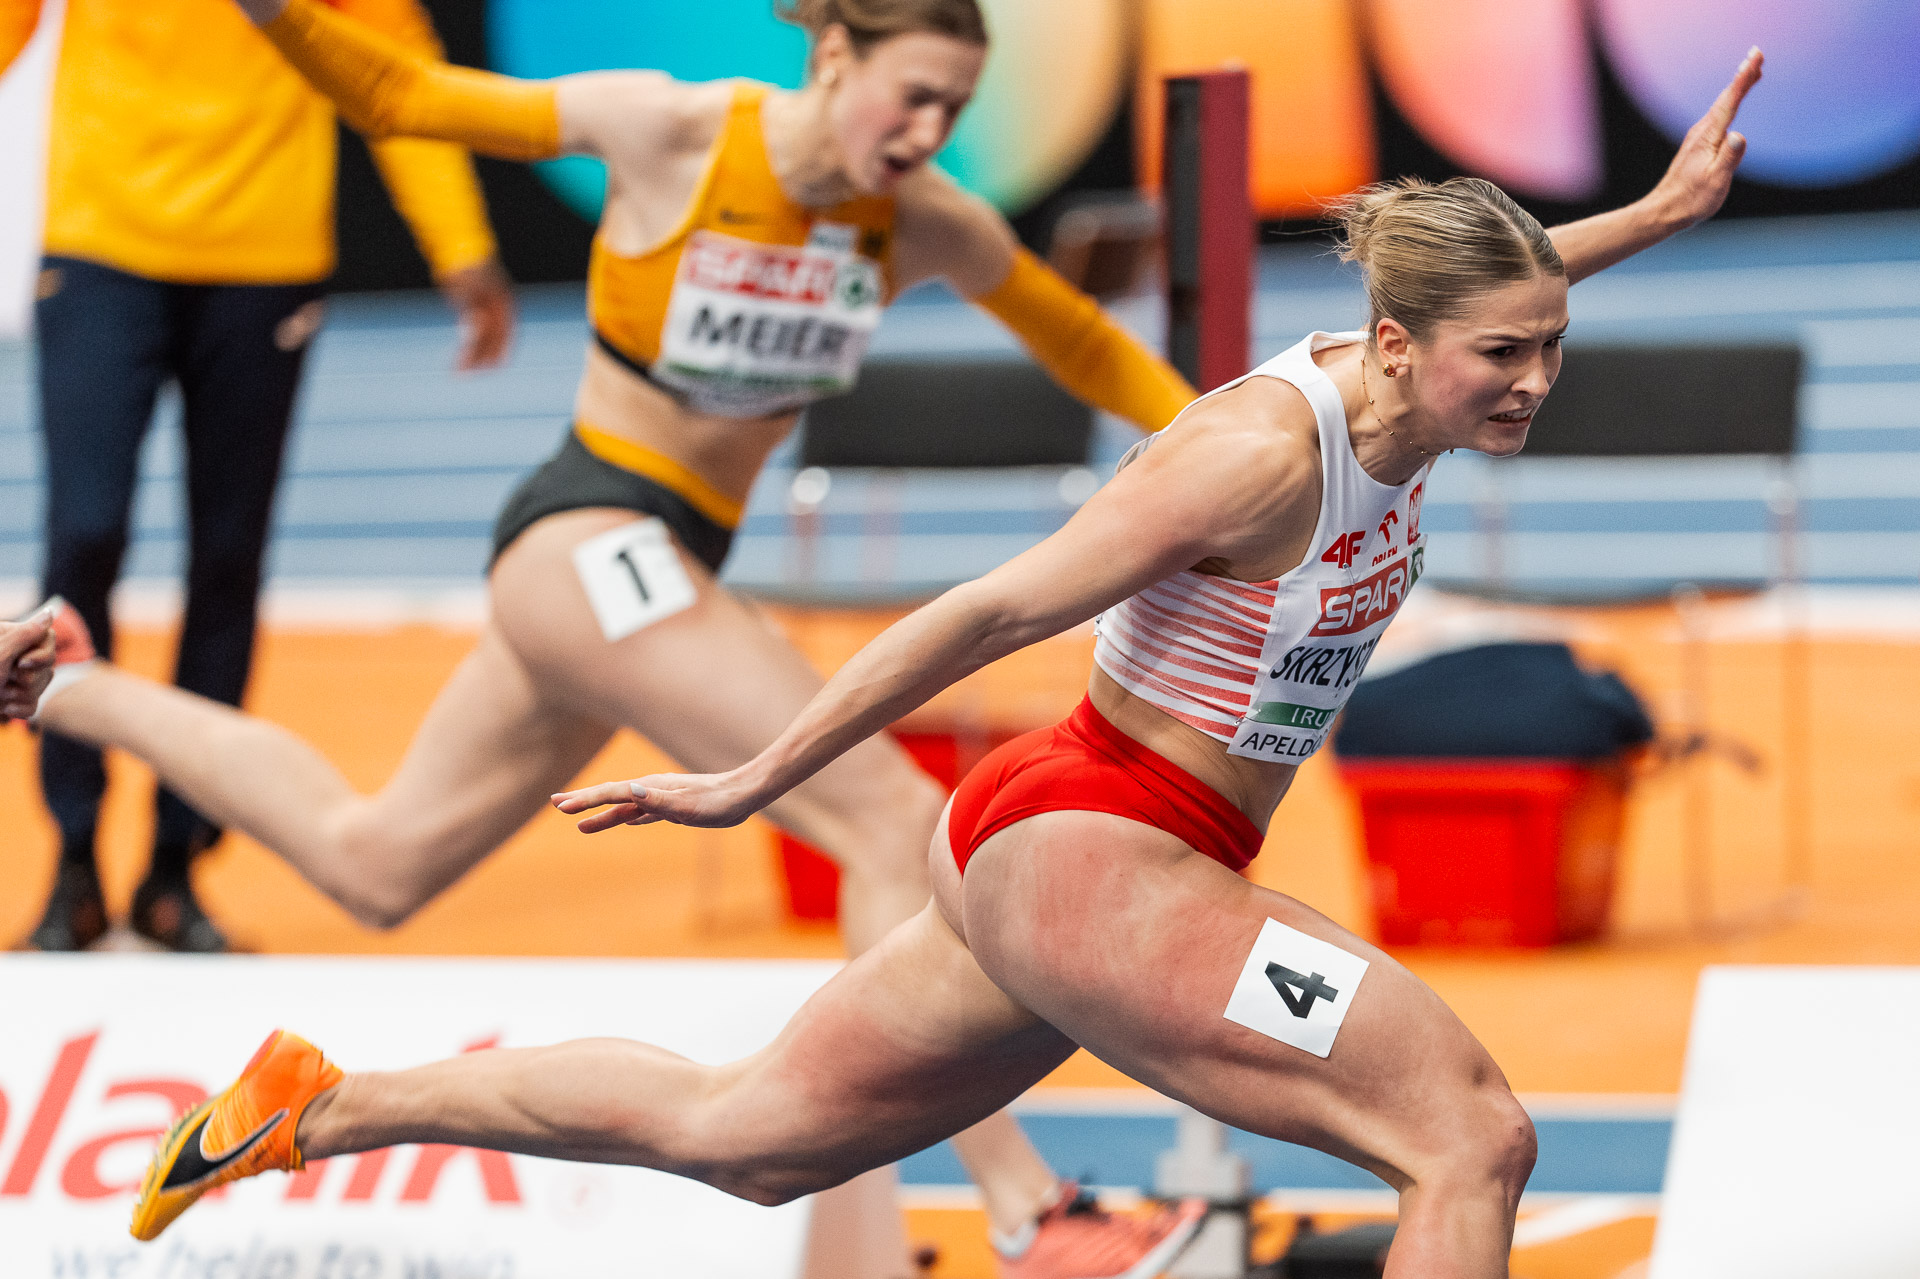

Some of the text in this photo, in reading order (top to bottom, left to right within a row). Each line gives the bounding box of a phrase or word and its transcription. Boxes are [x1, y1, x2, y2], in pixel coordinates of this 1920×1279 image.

[687, 304, 852, 362] MEIER
[613, 547, 652, 606] 1
[1321, 530, 1366, 569] 4F
[1317, 567, 1407, 630] SPAR
[1291, 706, 1334, 728] IRU
[1265, 961, 1339, 1019] 4
